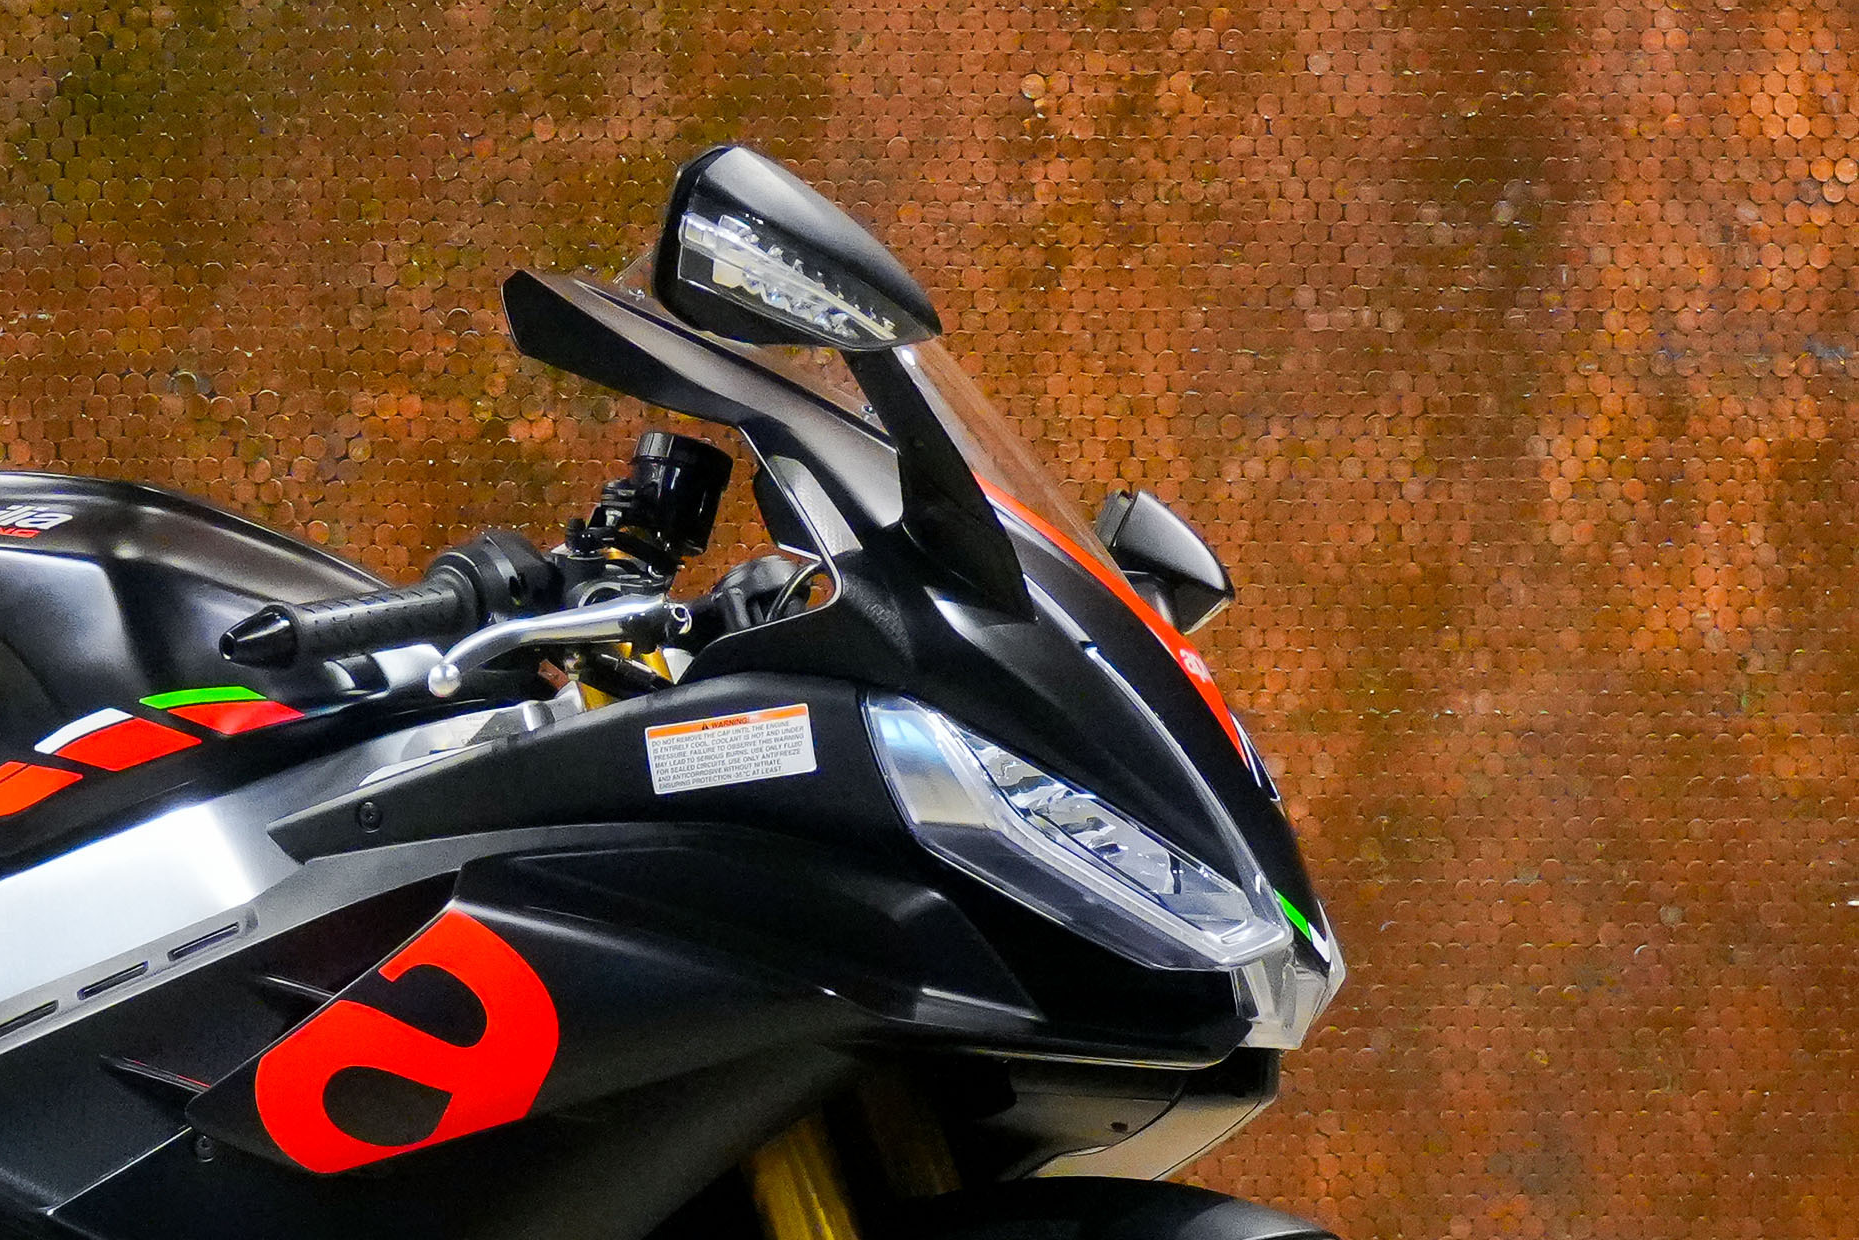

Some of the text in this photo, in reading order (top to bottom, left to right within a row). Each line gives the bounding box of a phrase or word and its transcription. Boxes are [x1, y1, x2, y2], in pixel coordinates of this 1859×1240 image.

[676, 734, 702, 743] REMOVE
[732, 727, 750, 735] UNTIL
[765, 721, 789, 729] ENGINE
[660, 744, 689, 753] ENTIRELY
[711, 736, 742, 745] COOLANT
[781, 726, 804, 735] UNDER
[765, 744, 782, 752] ONLY
[656, 768, 669, 776] FOR
[670, 764, 696, 774] SEALED
[743, 755, 759, 763] ONLY
[761, 766, 783, 774] LEAST
[657, 775, 671, 783] AND
